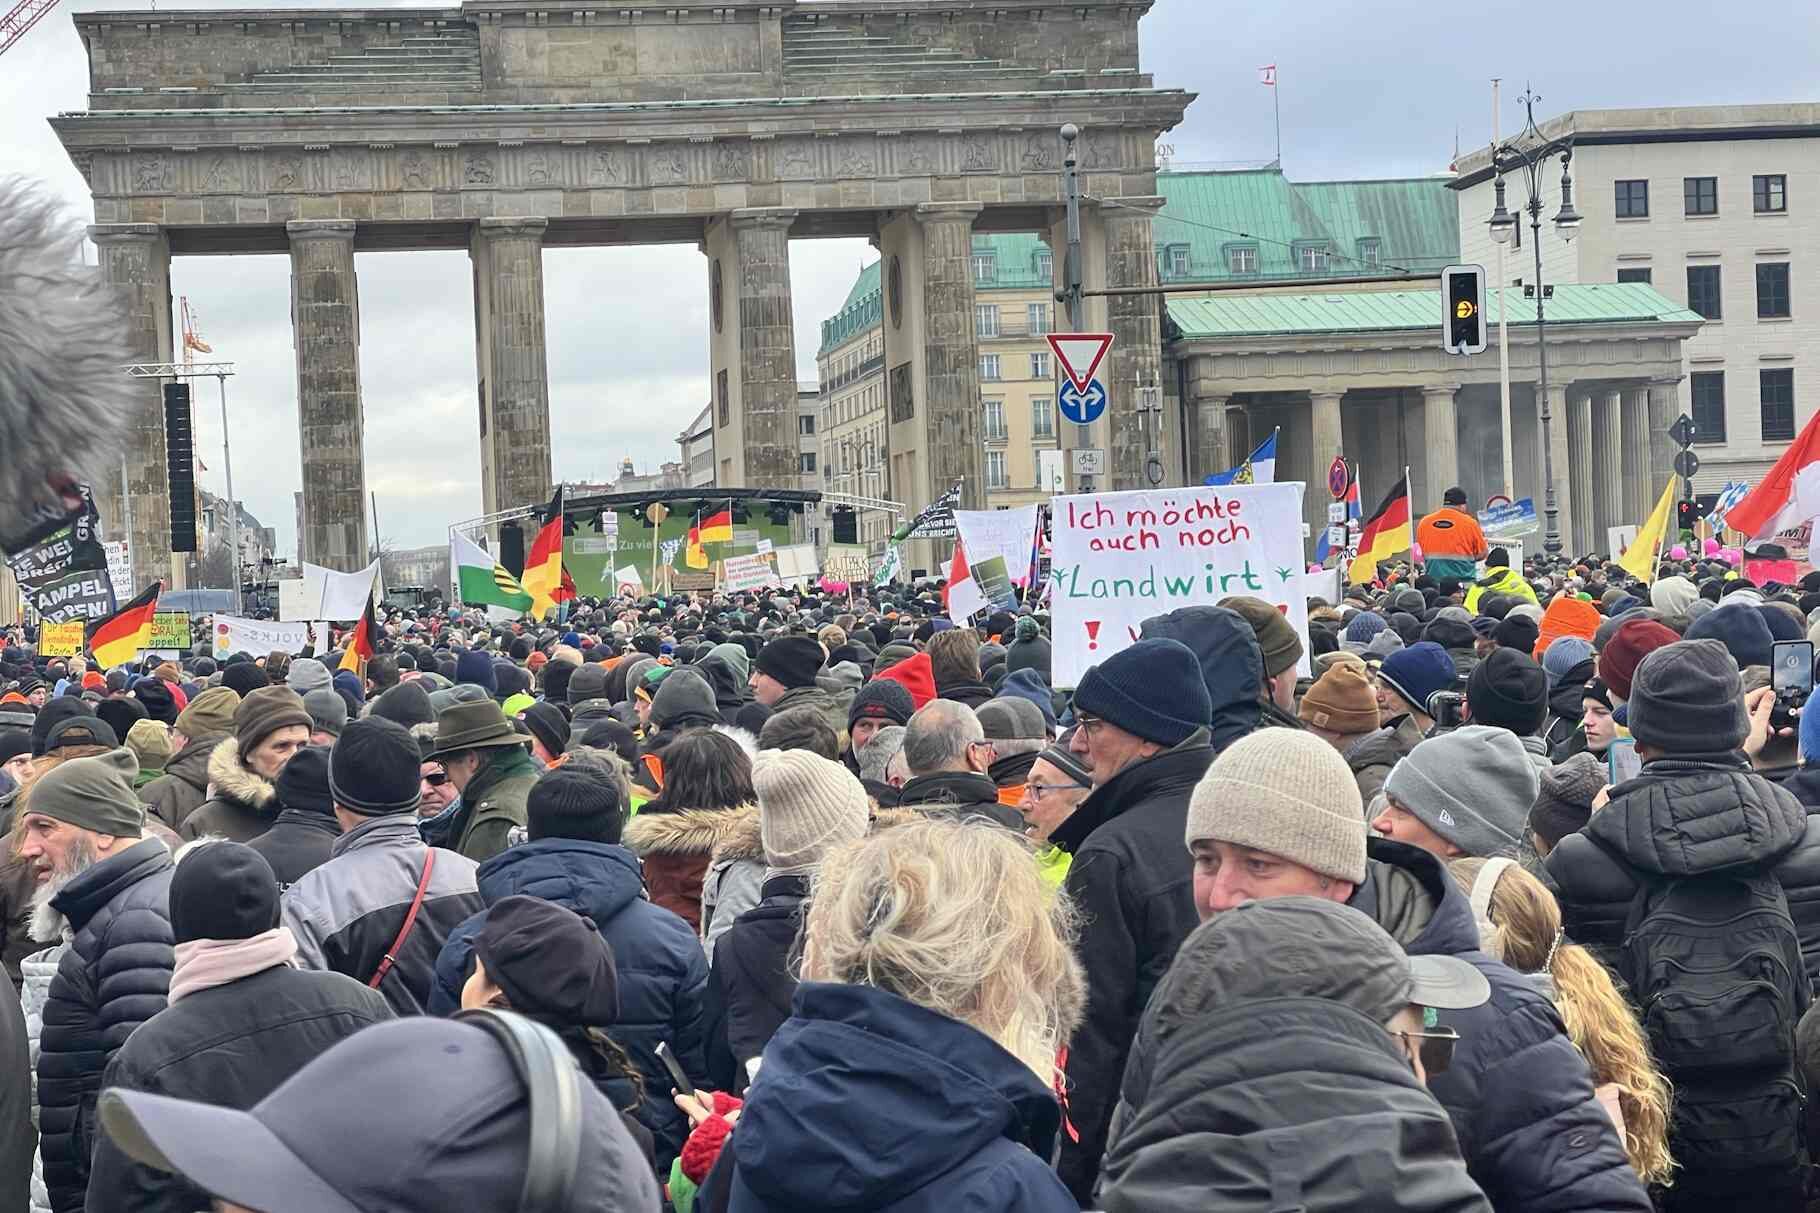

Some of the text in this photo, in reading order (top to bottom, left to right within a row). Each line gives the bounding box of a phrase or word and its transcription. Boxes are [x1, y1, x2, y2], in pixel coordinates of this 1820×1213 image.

[1068, 499, 1241, 529] Ich möchte
[1089, 520, 1250, 551] auch noch
[38, 579, 108, 609] AMPEL
[1069, 560, 1263, 598] Landwirt
